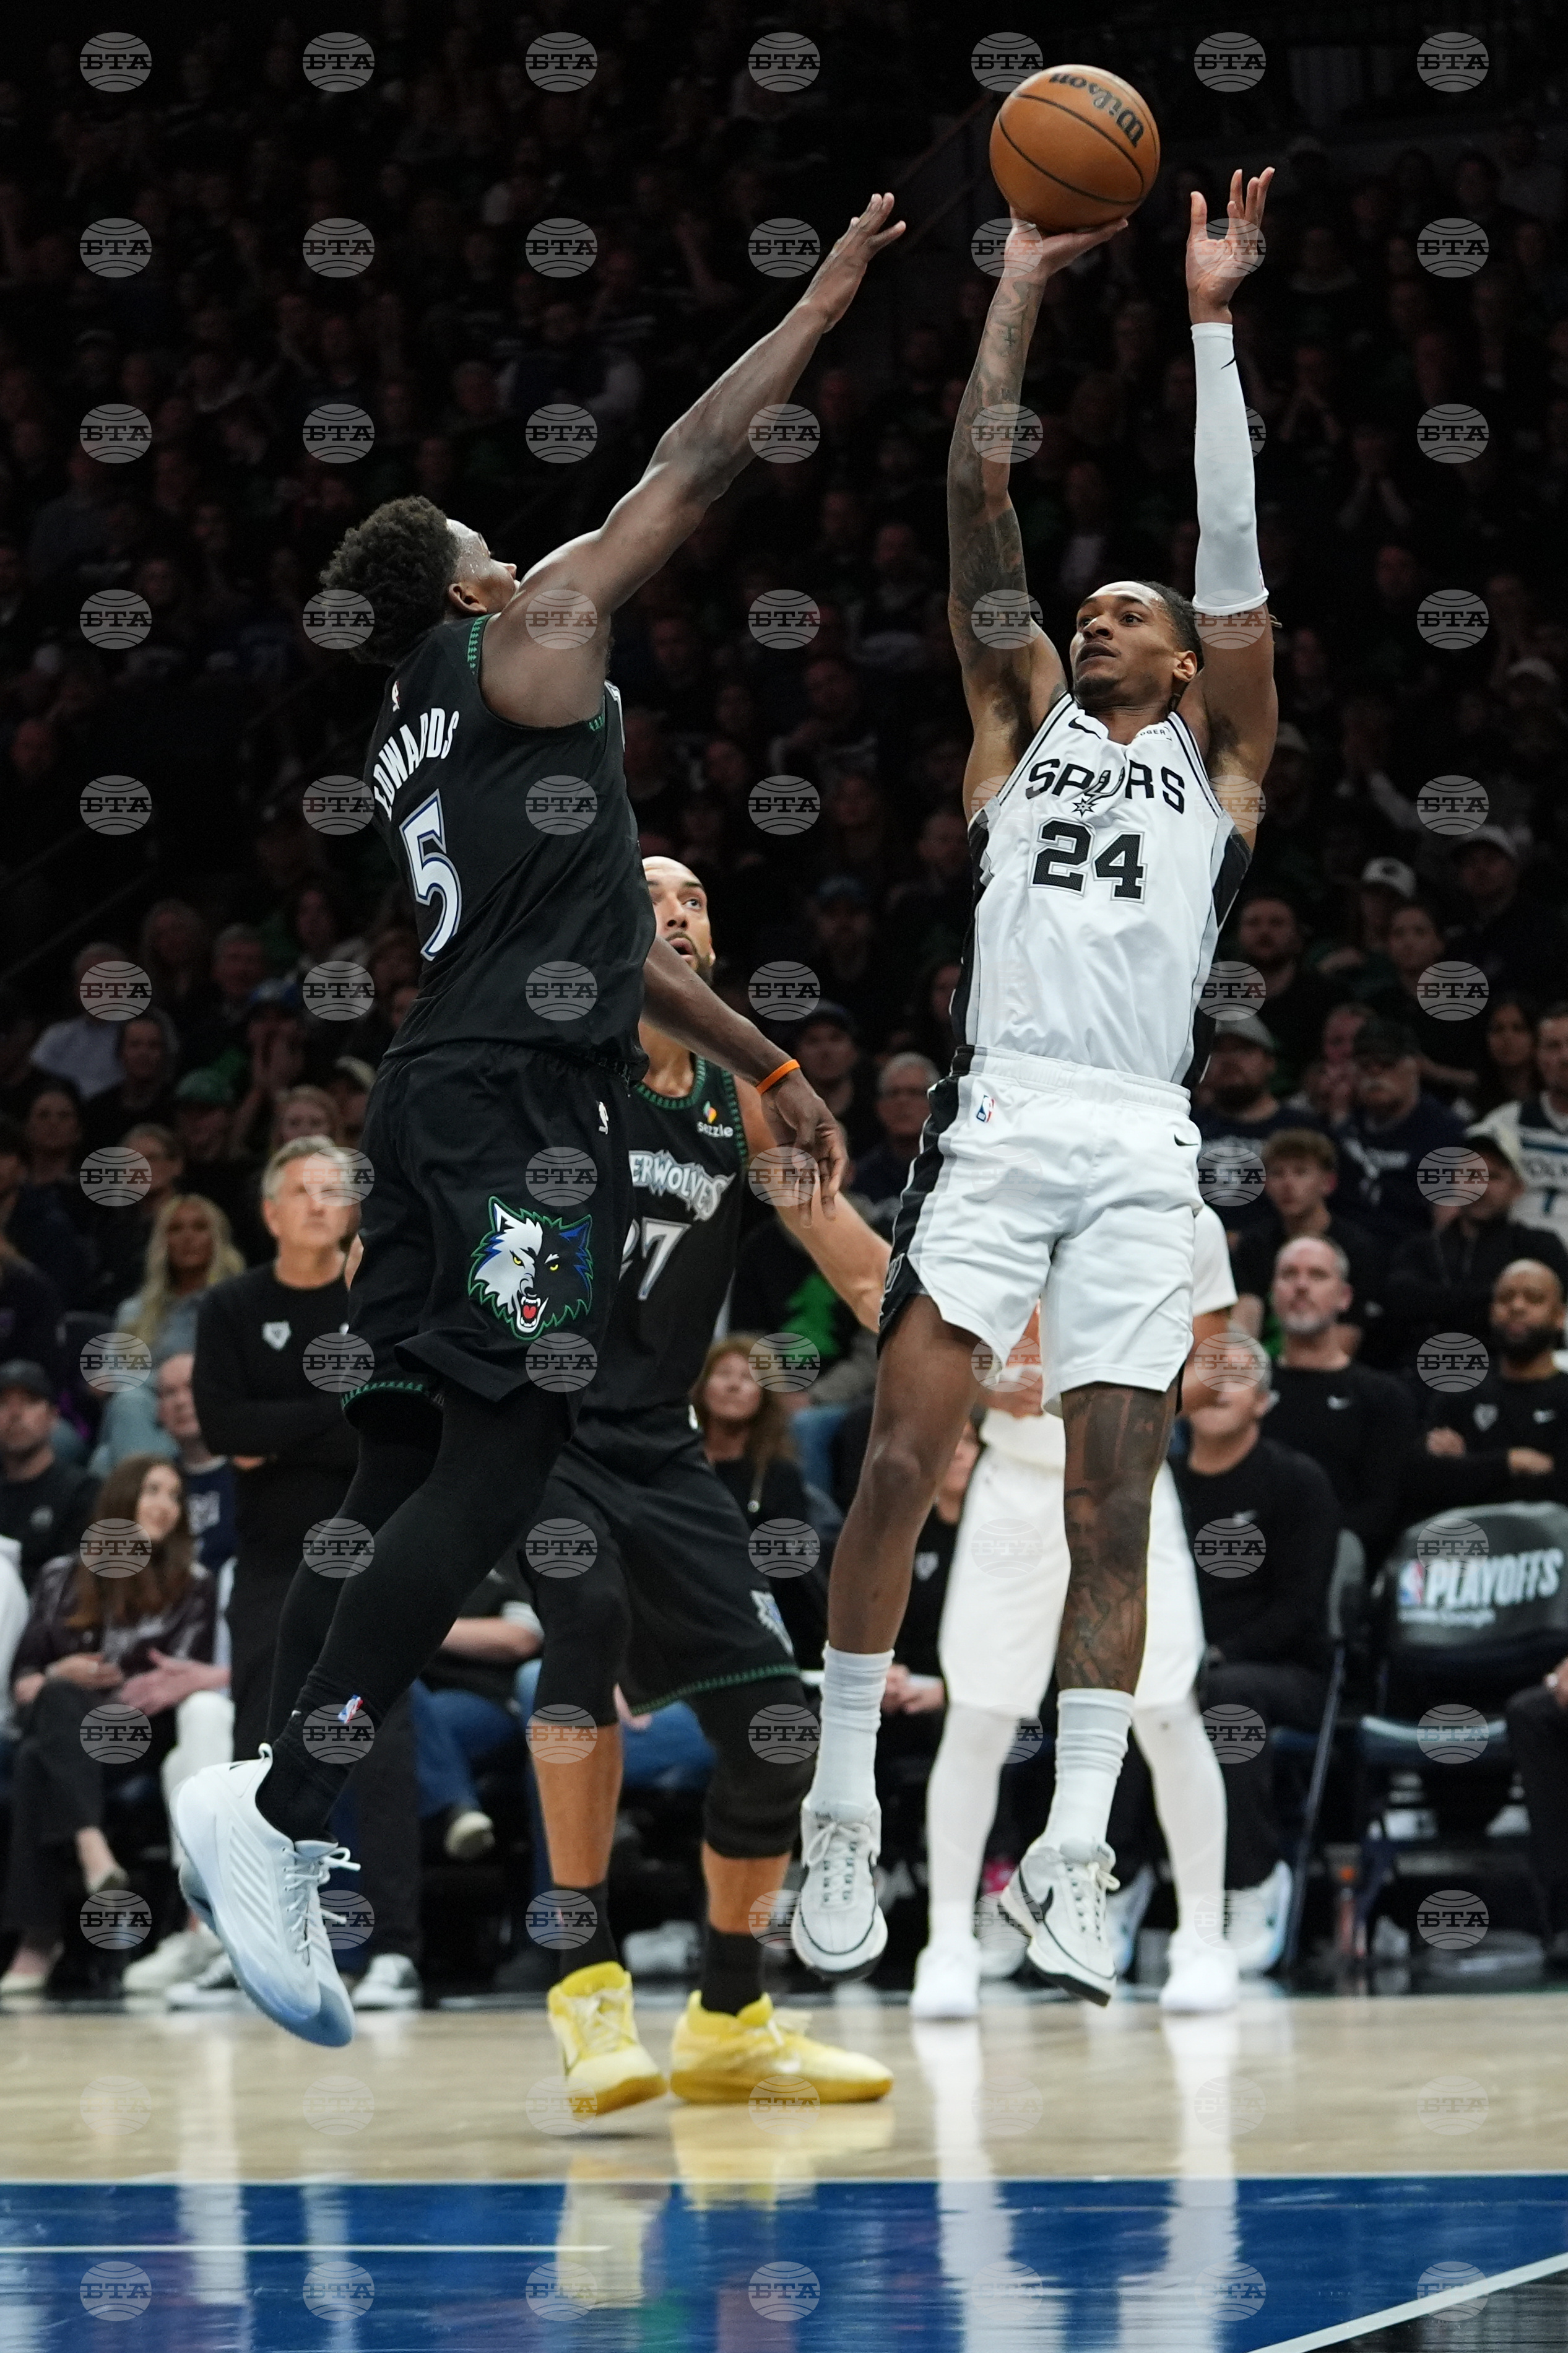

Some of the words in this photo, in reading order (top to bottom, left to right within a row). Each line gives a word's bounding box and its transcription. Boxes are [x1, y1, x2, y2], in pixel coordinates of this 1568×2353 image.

[1049, 74, 1144, 148] Wilson
[373, 708, 460, 822] EDWARDS
[1025, 759, 1185, 815] SPURS
[399, 788, 462, 962] 5
[1028, 817, 1148, 905] 24
[696, 1121, 734, 1138] sezzle
[628, 1150, 737, 1222] ERWOLVES
[1425, 1547, 1564, 1609] PLAYOFFS
